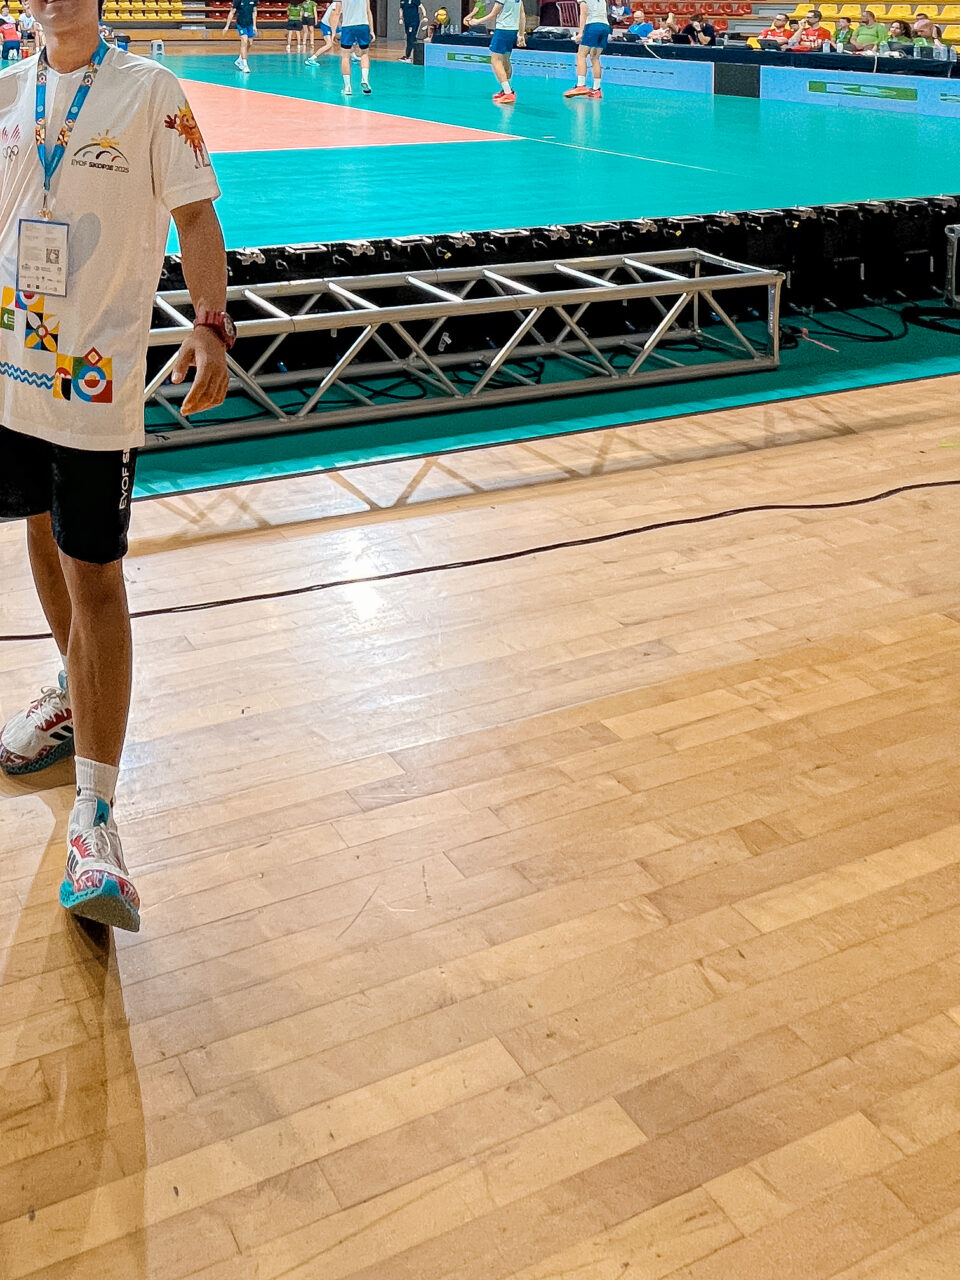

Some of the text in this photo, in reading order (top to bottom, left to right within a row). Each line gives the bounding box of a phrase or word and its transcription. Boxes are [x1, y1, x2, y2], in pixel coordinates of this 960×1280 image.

[71, 159, 88, 167] EYOF
[114, 165, 130, 174] 2025
[119, 466, 130, 510] EYOF
